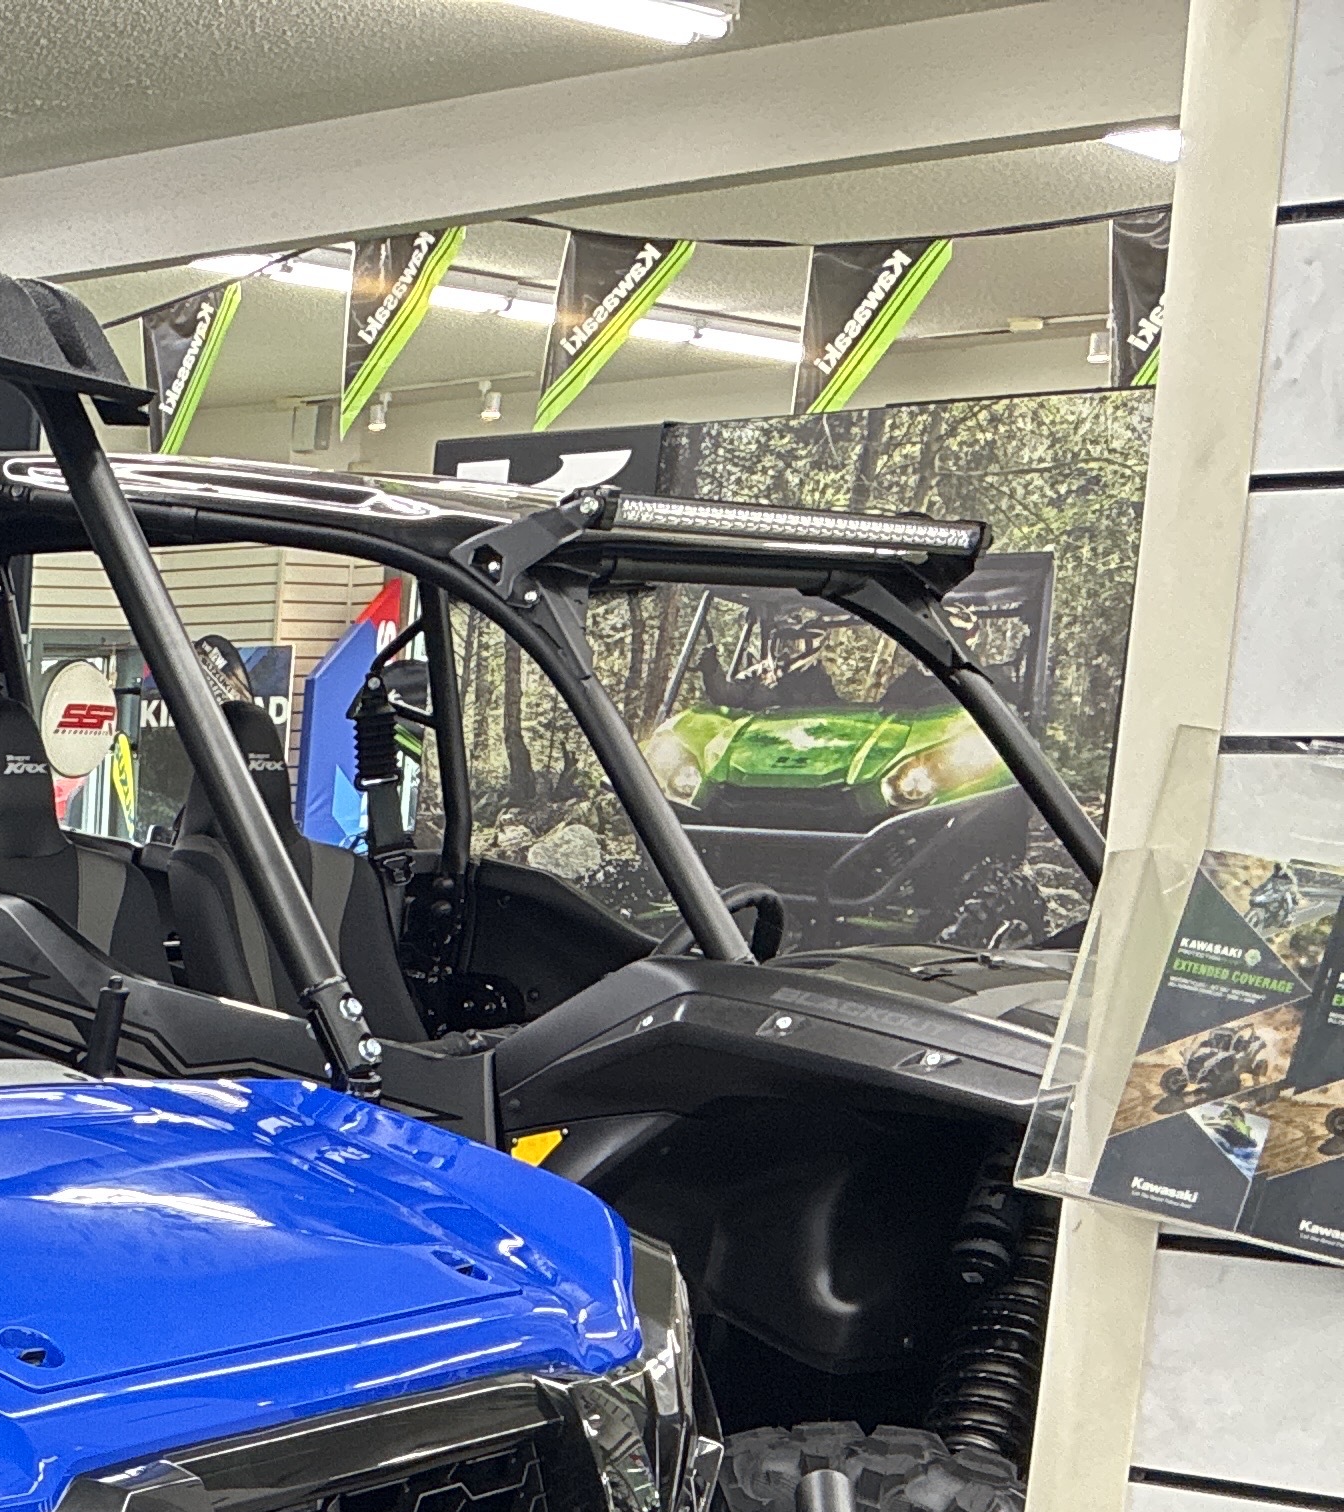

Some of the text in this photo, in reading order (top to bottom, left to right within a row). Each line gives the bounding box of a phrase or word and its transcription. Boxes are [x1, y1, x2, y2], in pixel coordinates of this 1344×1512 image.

[1180, 937, 1242, 959] KAWASAKI
[1173, 958, 1230, 981] EXTENDED
[1231, 970, 1295, 994] COVERAGE
[1131, 1176, 1199, 1204] Kawasaki
